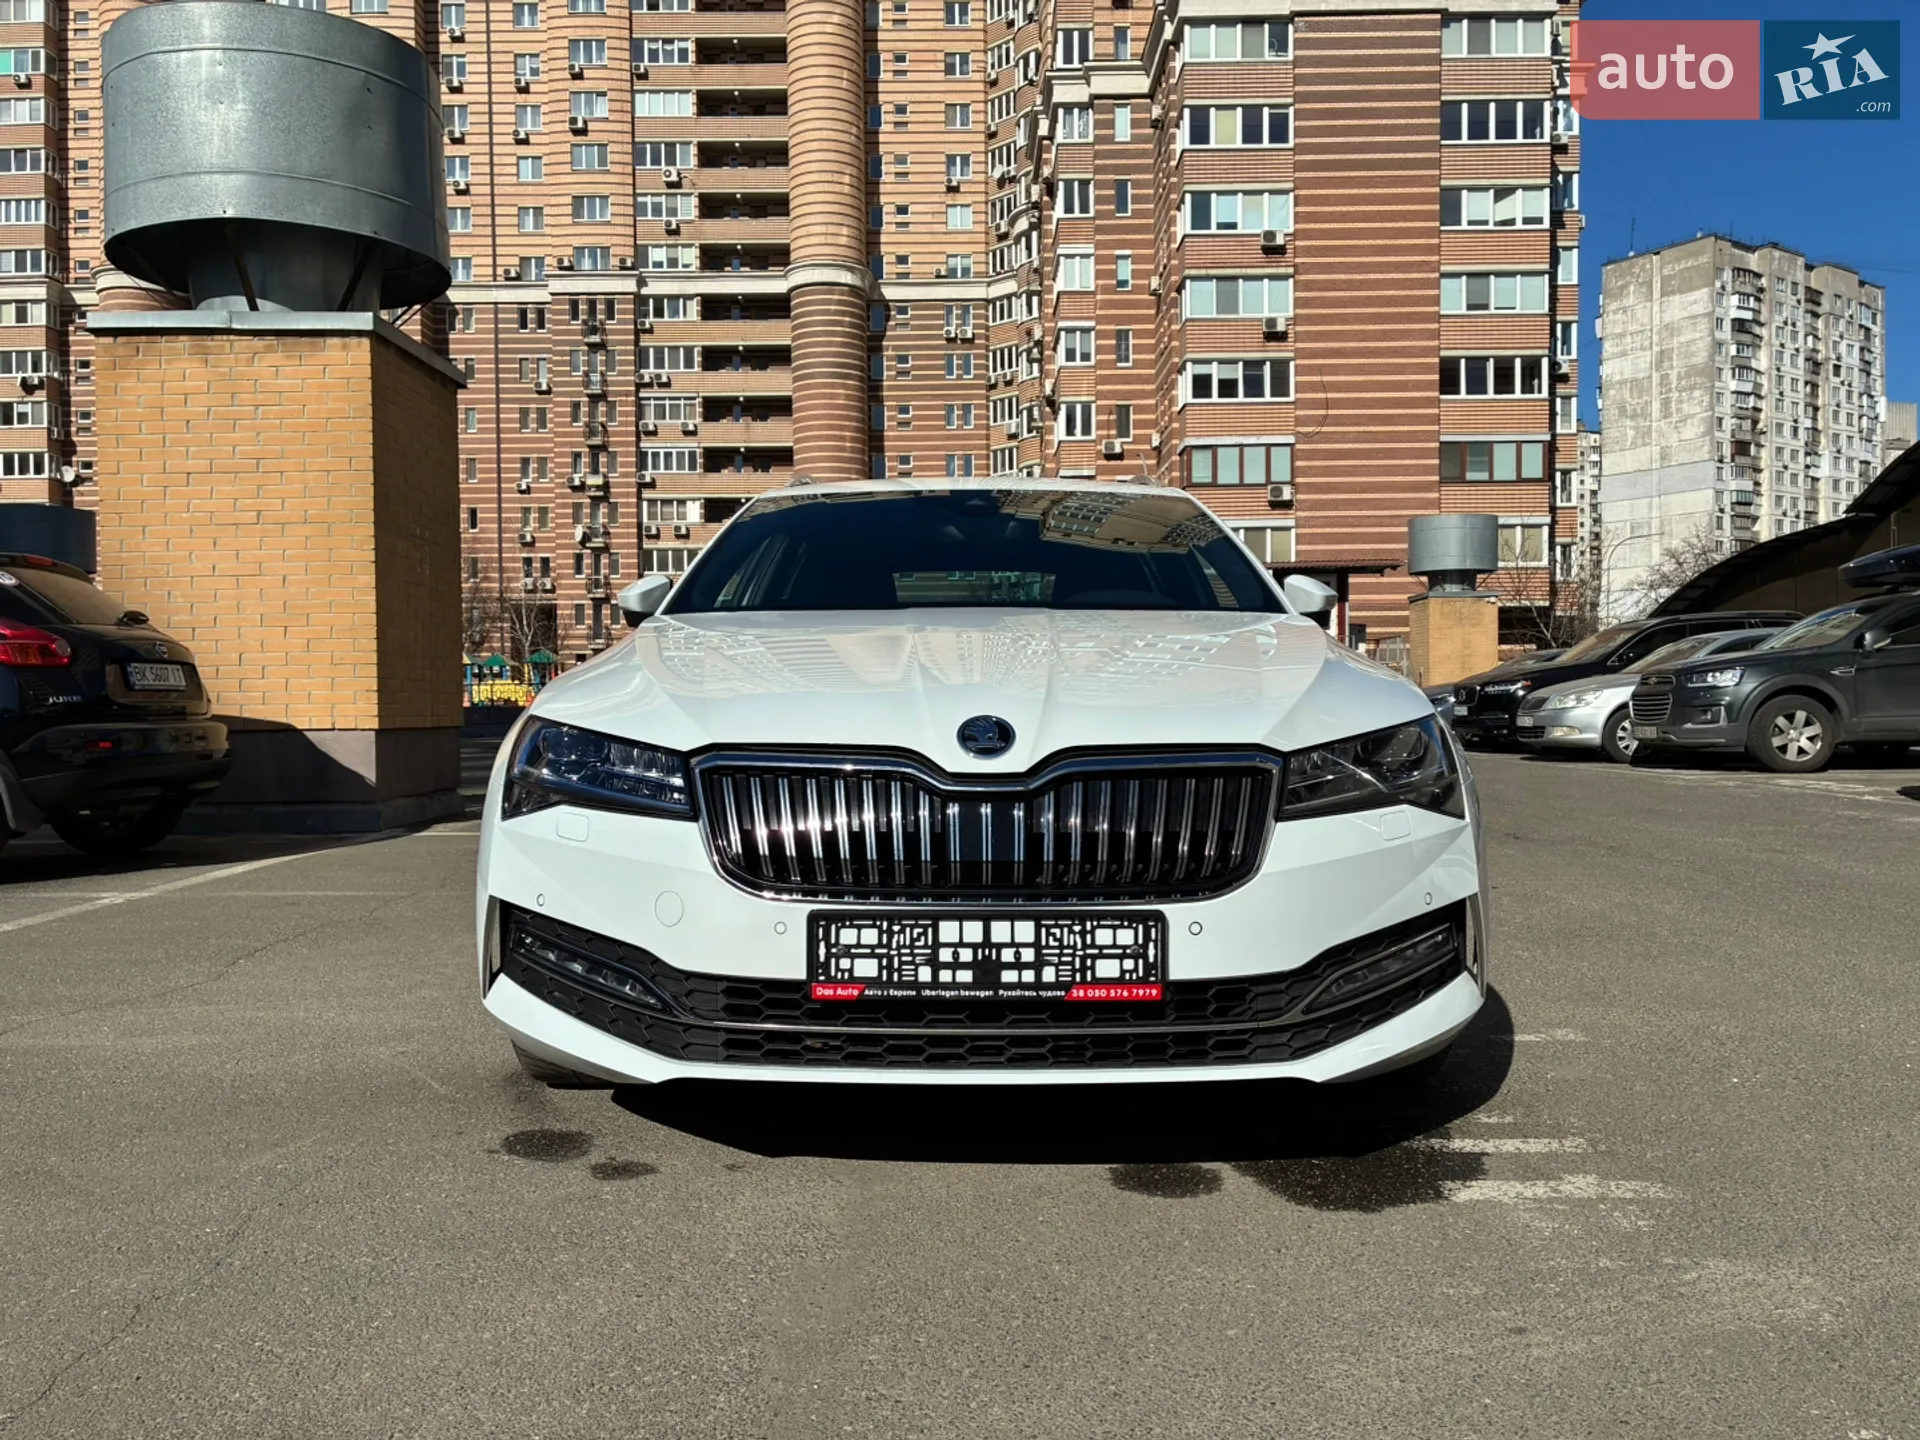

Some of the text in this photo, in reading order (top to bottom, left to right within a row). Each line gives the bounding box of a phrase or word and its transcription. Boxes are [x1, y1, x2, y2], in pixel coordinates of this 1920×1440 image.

[45, 695, 81, 705] JUKE
[816, 987, 859, 996] Das Auto
[1071, 988, 1158, 997] 38 050 576 7979
